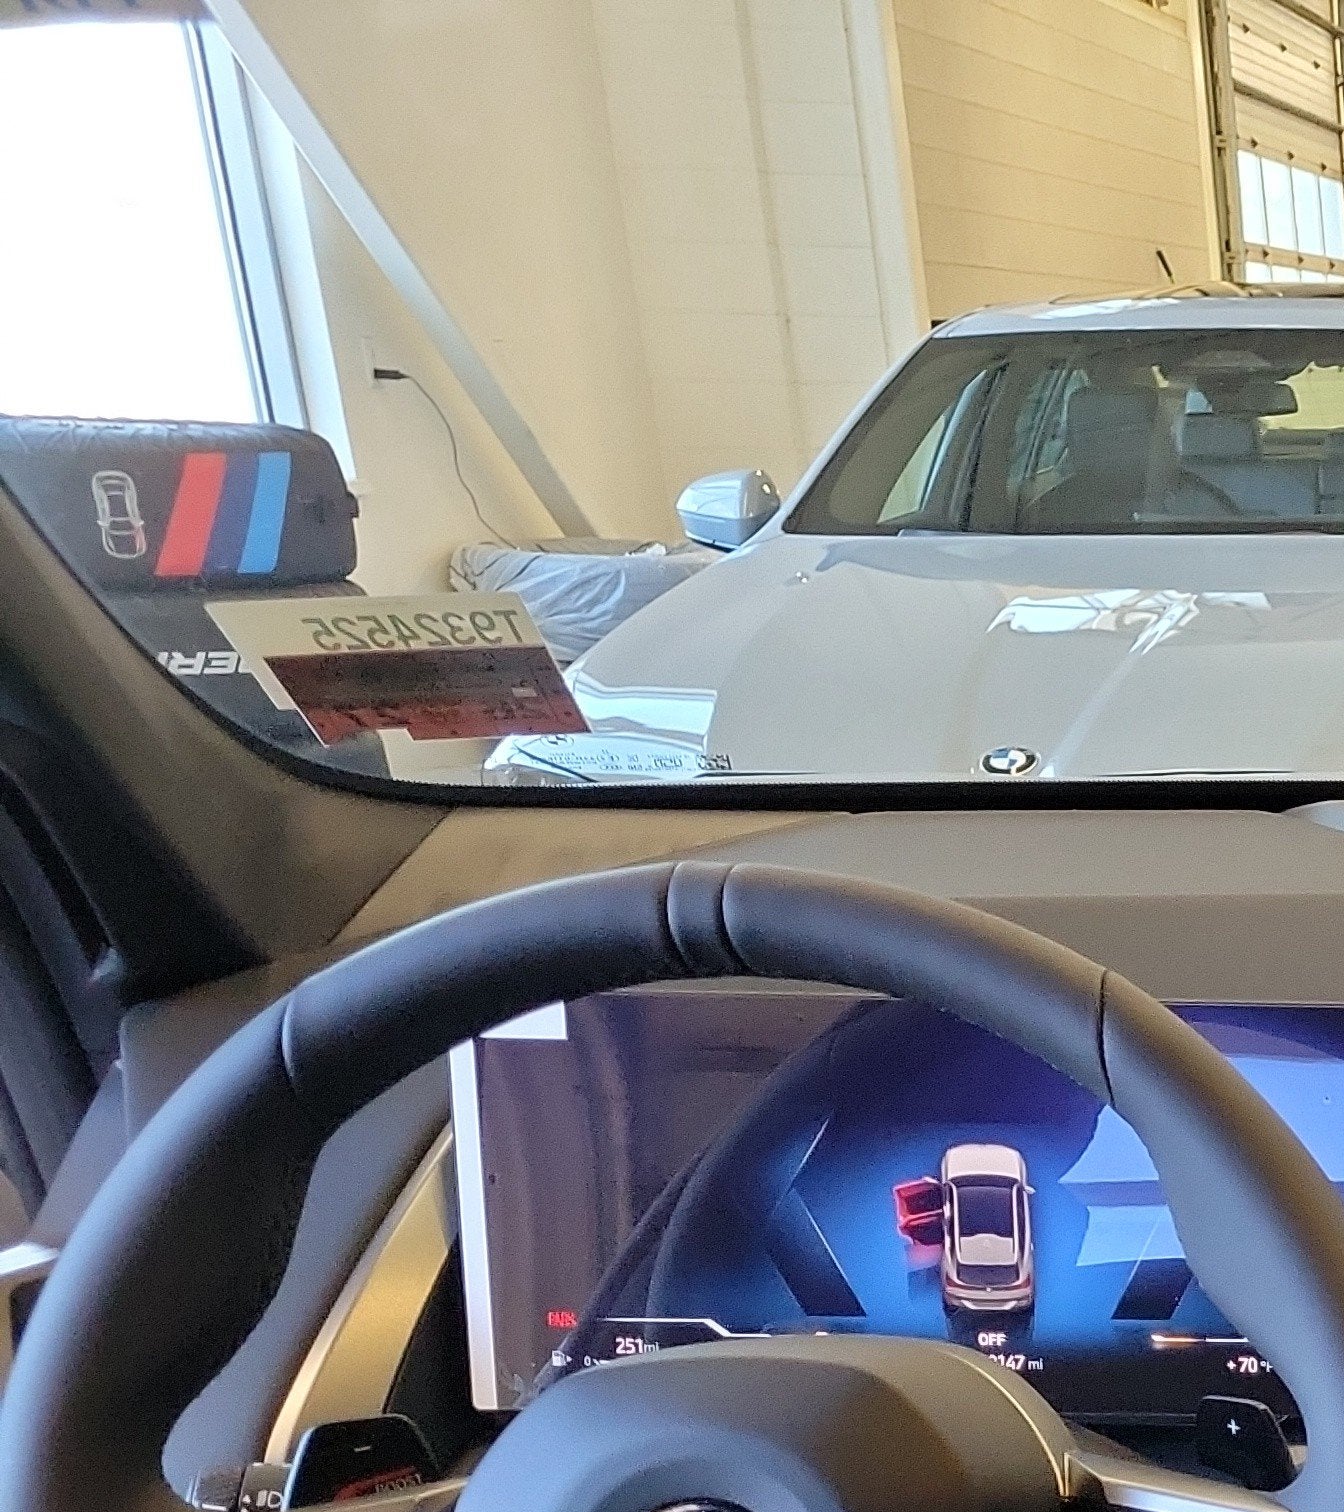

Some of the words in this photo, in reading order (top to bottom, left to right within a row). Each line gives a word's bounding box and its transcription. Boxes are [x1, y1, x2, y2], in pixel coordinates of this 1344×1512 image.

[978, 1332, 1007, 1346] OFF
[583, 1356, 591, 1366] 0
[1028, 1357, 1044, 1370] mi
